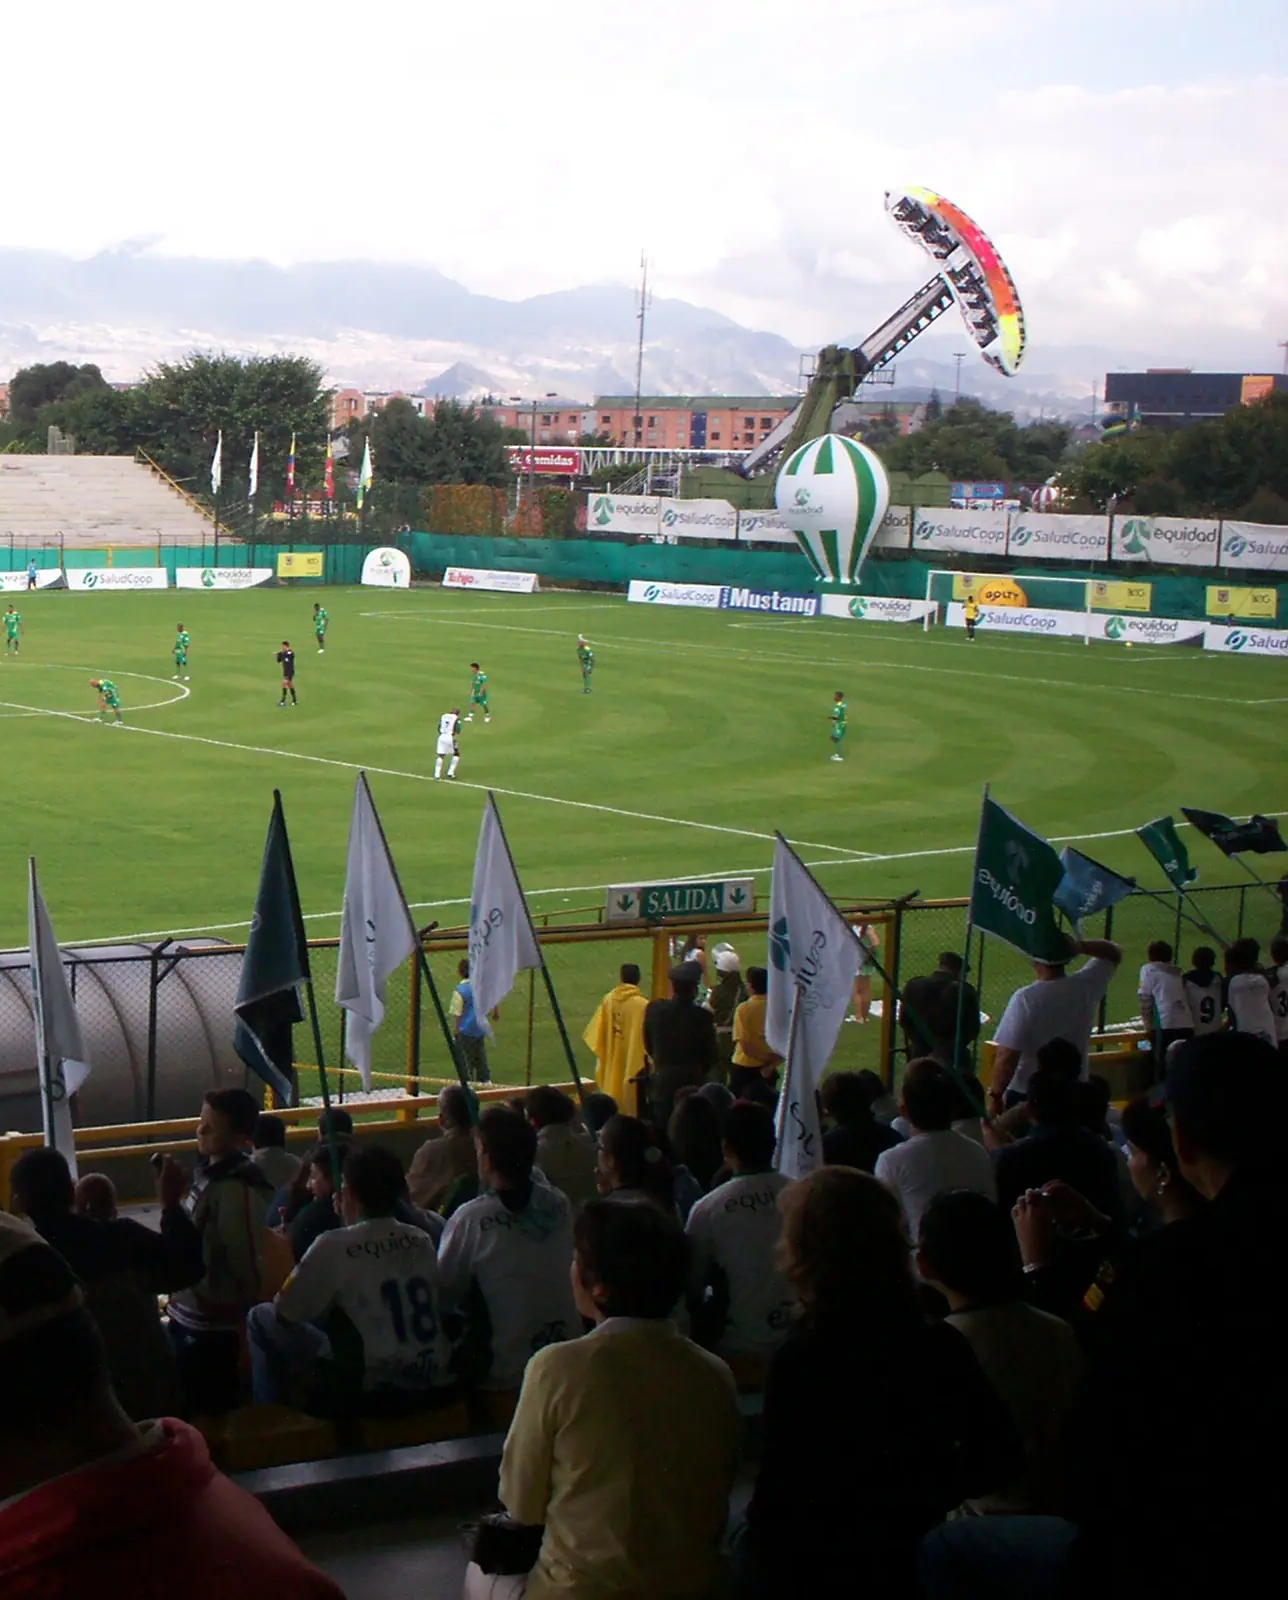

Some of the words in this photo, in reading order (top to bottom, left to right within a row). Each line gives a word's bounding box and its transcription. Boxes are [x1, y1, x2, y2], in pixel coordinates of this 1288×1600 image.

[616, 501, 658, 516] equidad
[677, 512, 735, 528] SaludCoop
[934, 524, 1005, 543] SaludCoop
[1033, 529, 1107, 548] SaludCoop
[1153, 526, 1217, 543] equidad
[99, 573, 154, 585] SaludCoop
[660, 588, 716, 603] SaludCoop
[729, 587, 817, 616] Mustang
[869, 599, 912, 612] equidad
[987, 611, 1057, 630] SaludCoop
[1128, 619, 1179, 633] equidad
[1248, 635, 1288, 650] Salud
[647, 887, 720, 914] SALIDA
[1199, 995, 1216, 1024] 9
[380, 1274, 437, 1344] 18
